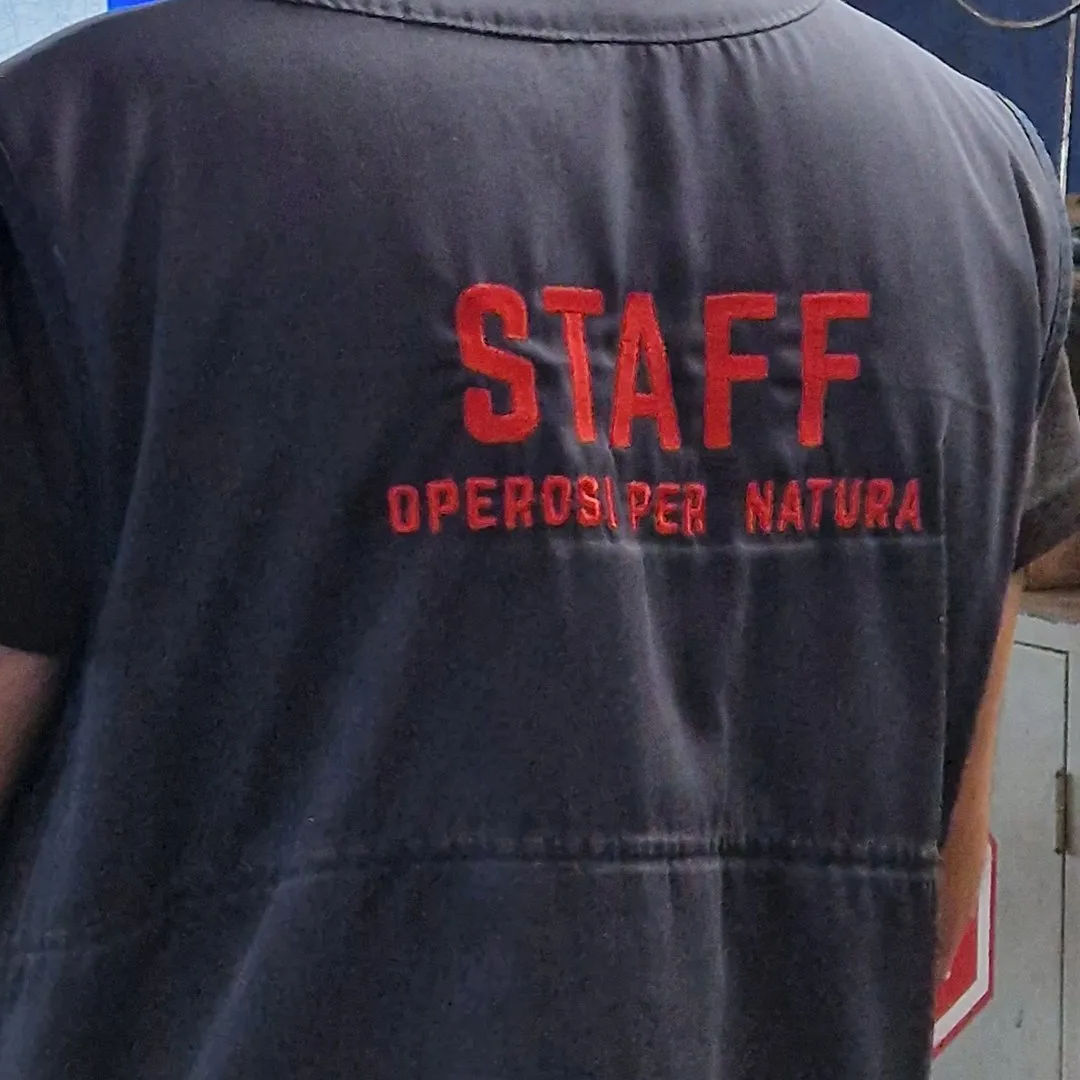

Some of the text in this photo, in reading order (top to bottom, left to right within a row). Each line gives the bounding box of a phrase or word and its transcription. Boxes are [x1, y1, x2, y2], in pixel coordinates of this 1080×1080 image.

[455, 282, 871, 451] STAFF
[387, 475, 922, 536] OPEROSI PER NATURA
